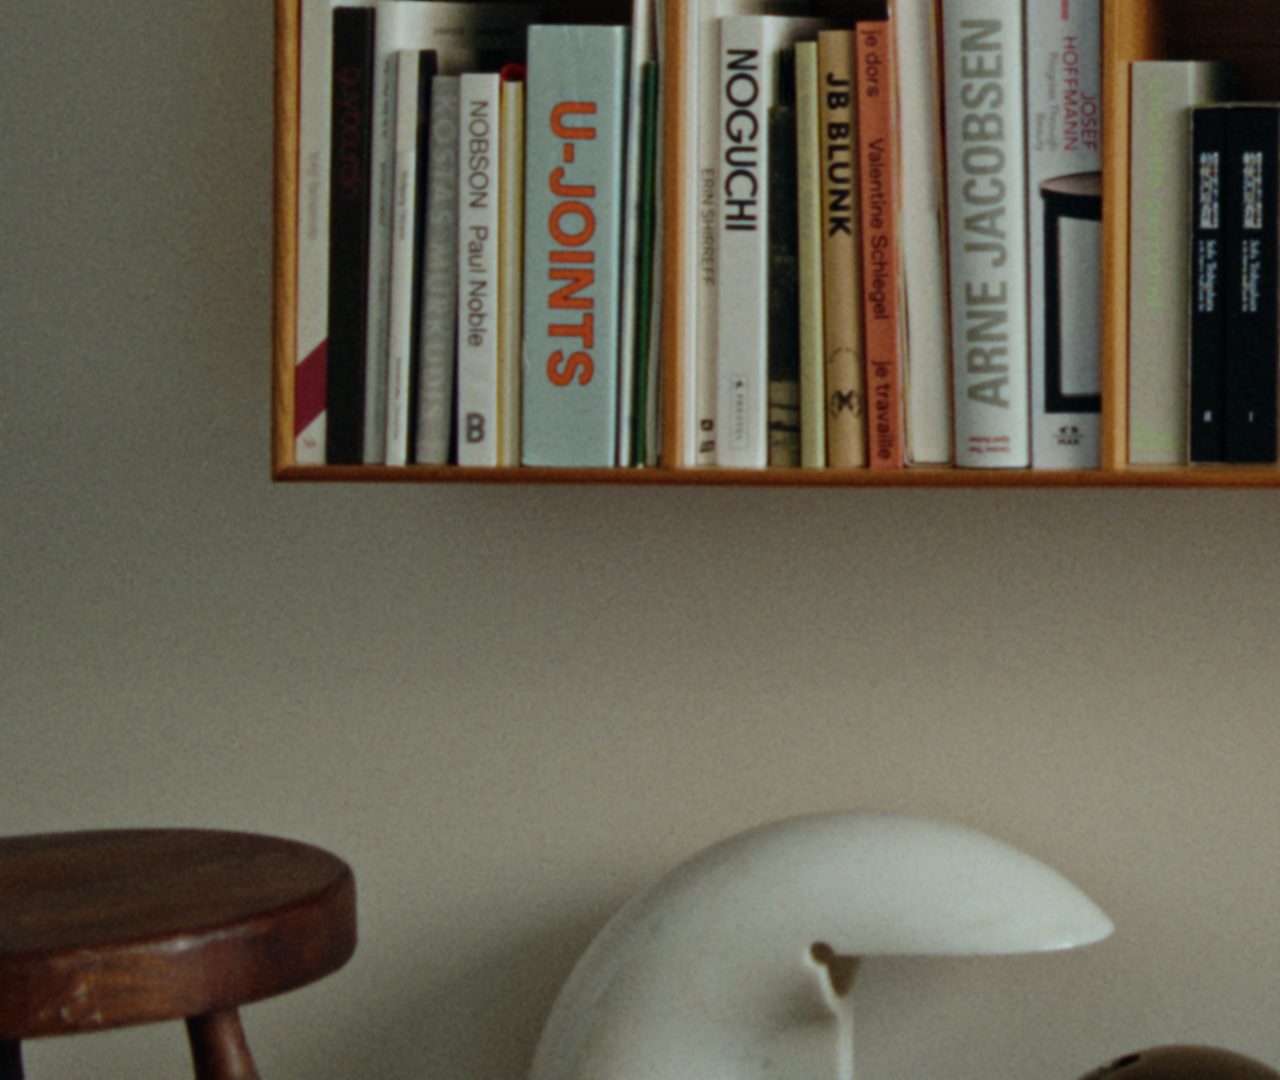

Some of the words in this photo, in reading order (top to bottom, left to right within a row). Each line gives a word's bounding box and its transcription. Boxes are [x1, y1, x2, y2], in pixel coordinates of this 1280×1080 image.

[862, 28, 884, 50] je
[865, 51, 884, 99] dors
[826, 71, 852, 111] JB
[1061, 34, 1079, 152] HOFFMANN
[1079, 90, 1098, 152] JOSEF
[1147, 78, 1176, 188] charlotte
[431, 94, 456, 225] KOSTAS
[468, 100, 489, 209] NOBSON
[701, 168, 716, 207] ERIN
[725, 47, 760, 232] NOGUCHI
[827, 120, 853, 238] BLUNK
[866, 136, 889, 232] Valentine
[959, 17, 1008, 267] JACOBSEN
[468, 225, 489, 274] Paul
[547, 99, 598, 388] U-JOINTS
[701, 209, 716, 287] SHIRREFF
[867, 235, 892, 321] Schlegel
[1143, 198, 1174, 309] perriand
[425, 242, 452, 420] MURKUDIS
[468, 280, 489, 348] Noble
[964, 280, 1010, 410] ARNE
[872, 359, 893, 381] je
[875, 383, 895, 461] travaille
